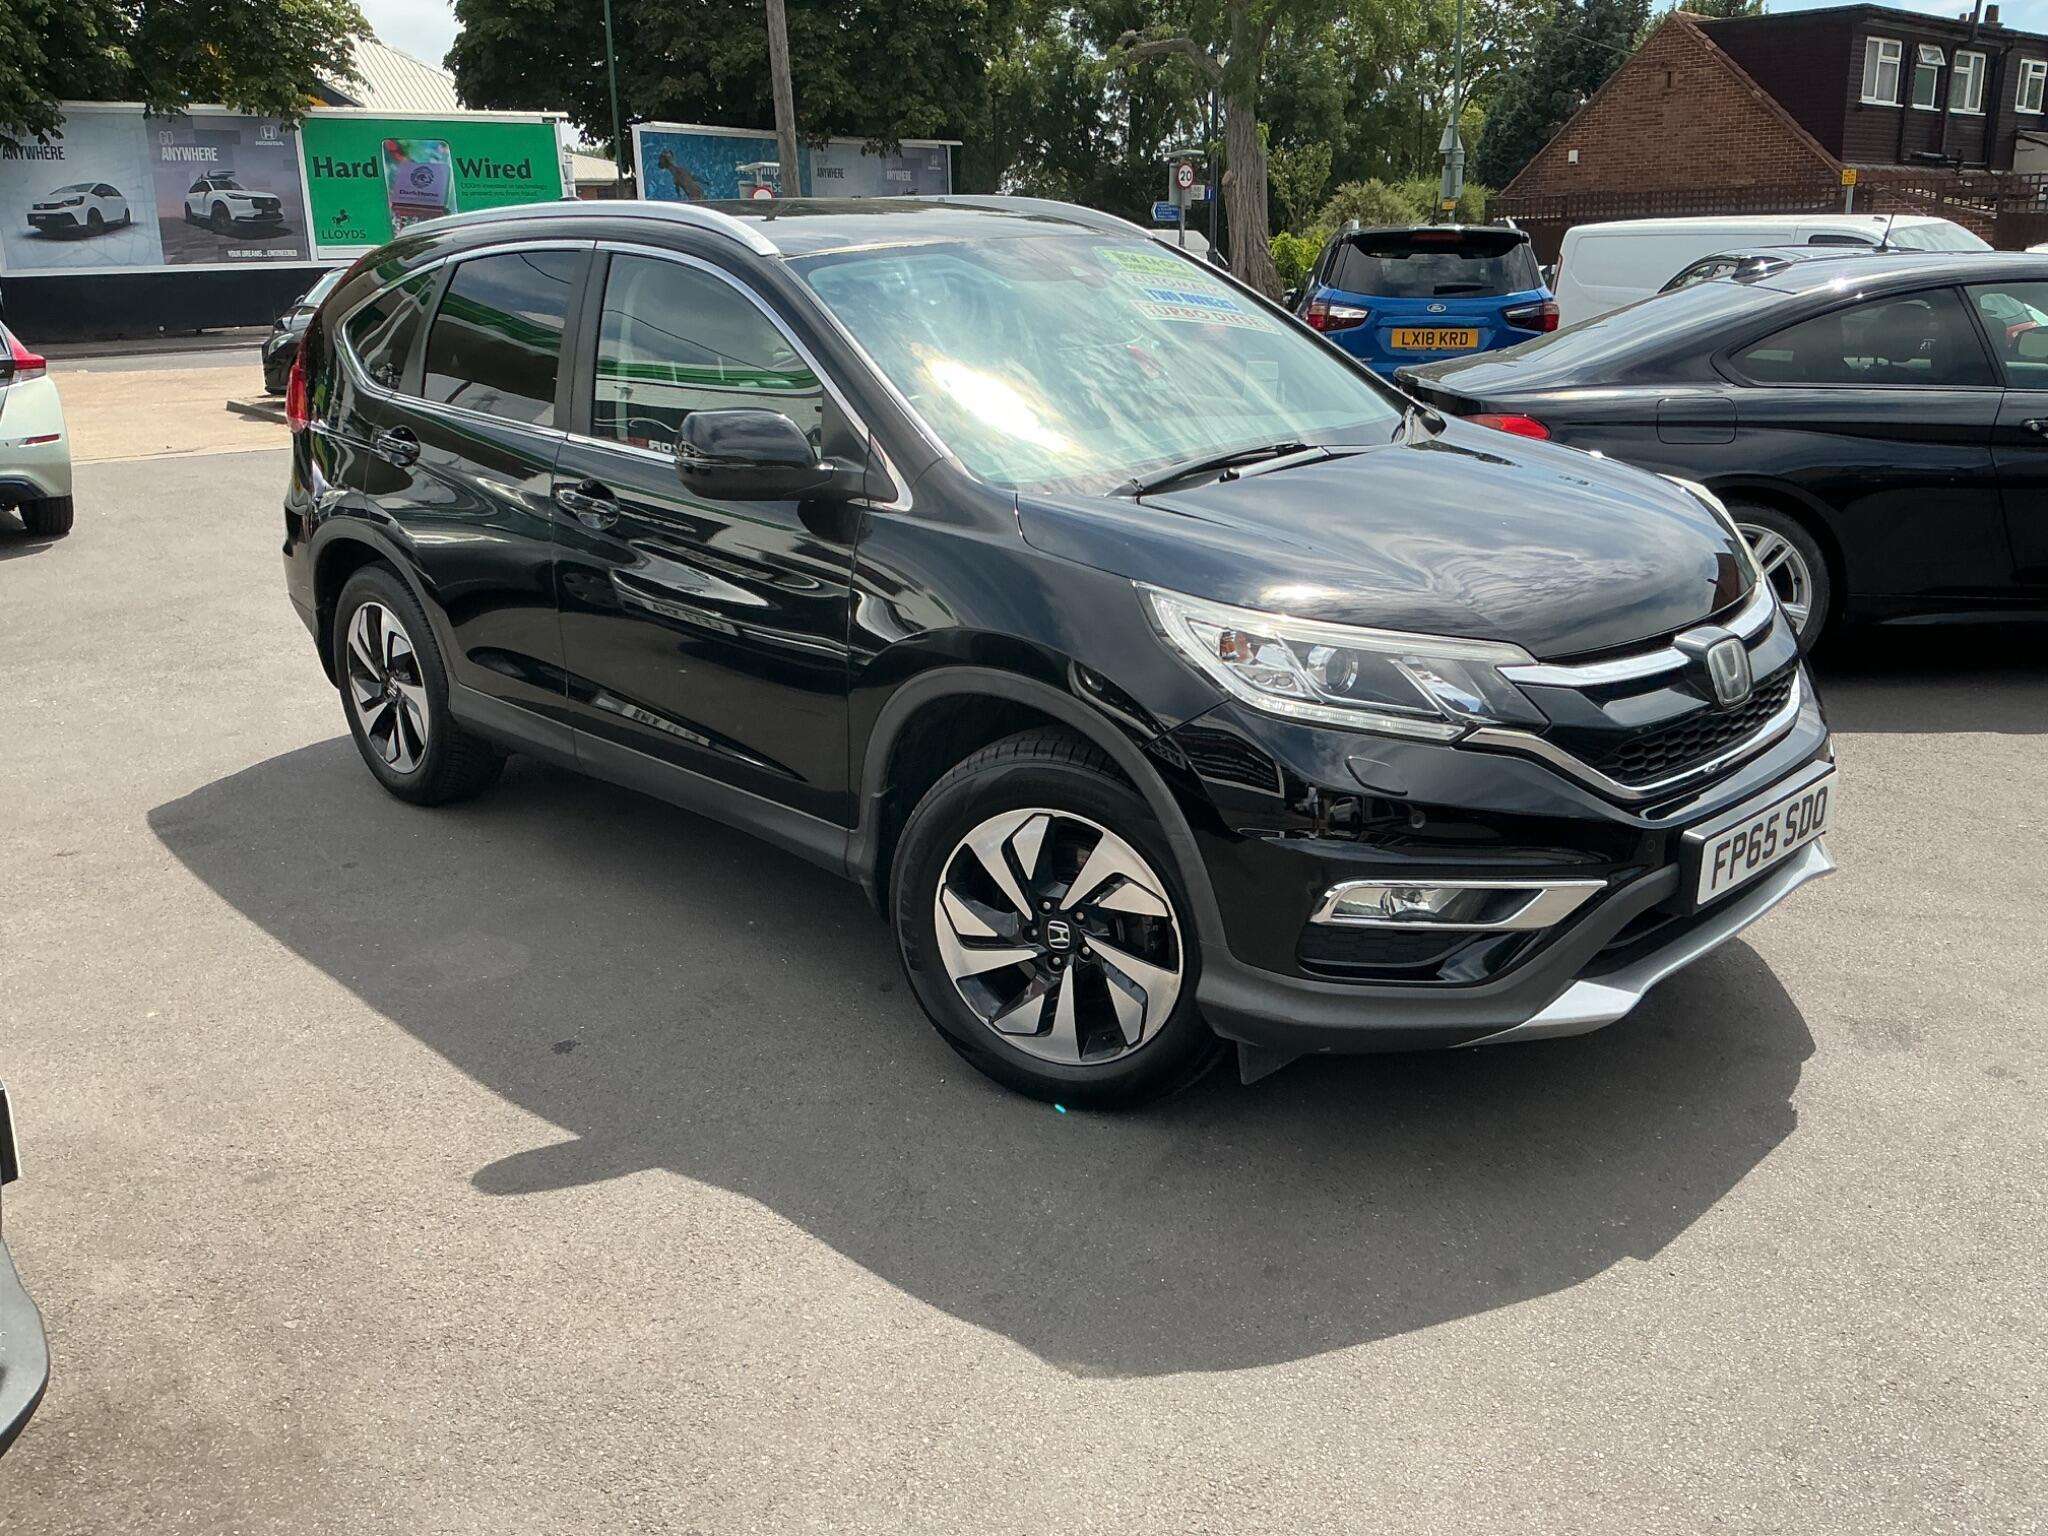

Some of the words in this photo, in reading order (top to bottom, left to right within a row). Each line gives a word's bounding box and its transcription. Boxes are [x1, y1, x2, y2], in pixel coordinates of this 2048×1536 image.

[2, 144, 66, 161] ANYWHERE
[161, 146, 219, 162] ANYWHERE
[312, 155, 380, 179] Hard
[456, 157, 532, 179] Wired
[817, 167, 845, 180] ANYWHERE
[1180, 170, 1192, 182] 20
[322, 228, 367, 240] LLOYDS
[1401, 330, 1435, 346] LX18
[1438, 330, 1469, 346] KRD
[1711, 812, 1780, 891] FP65
